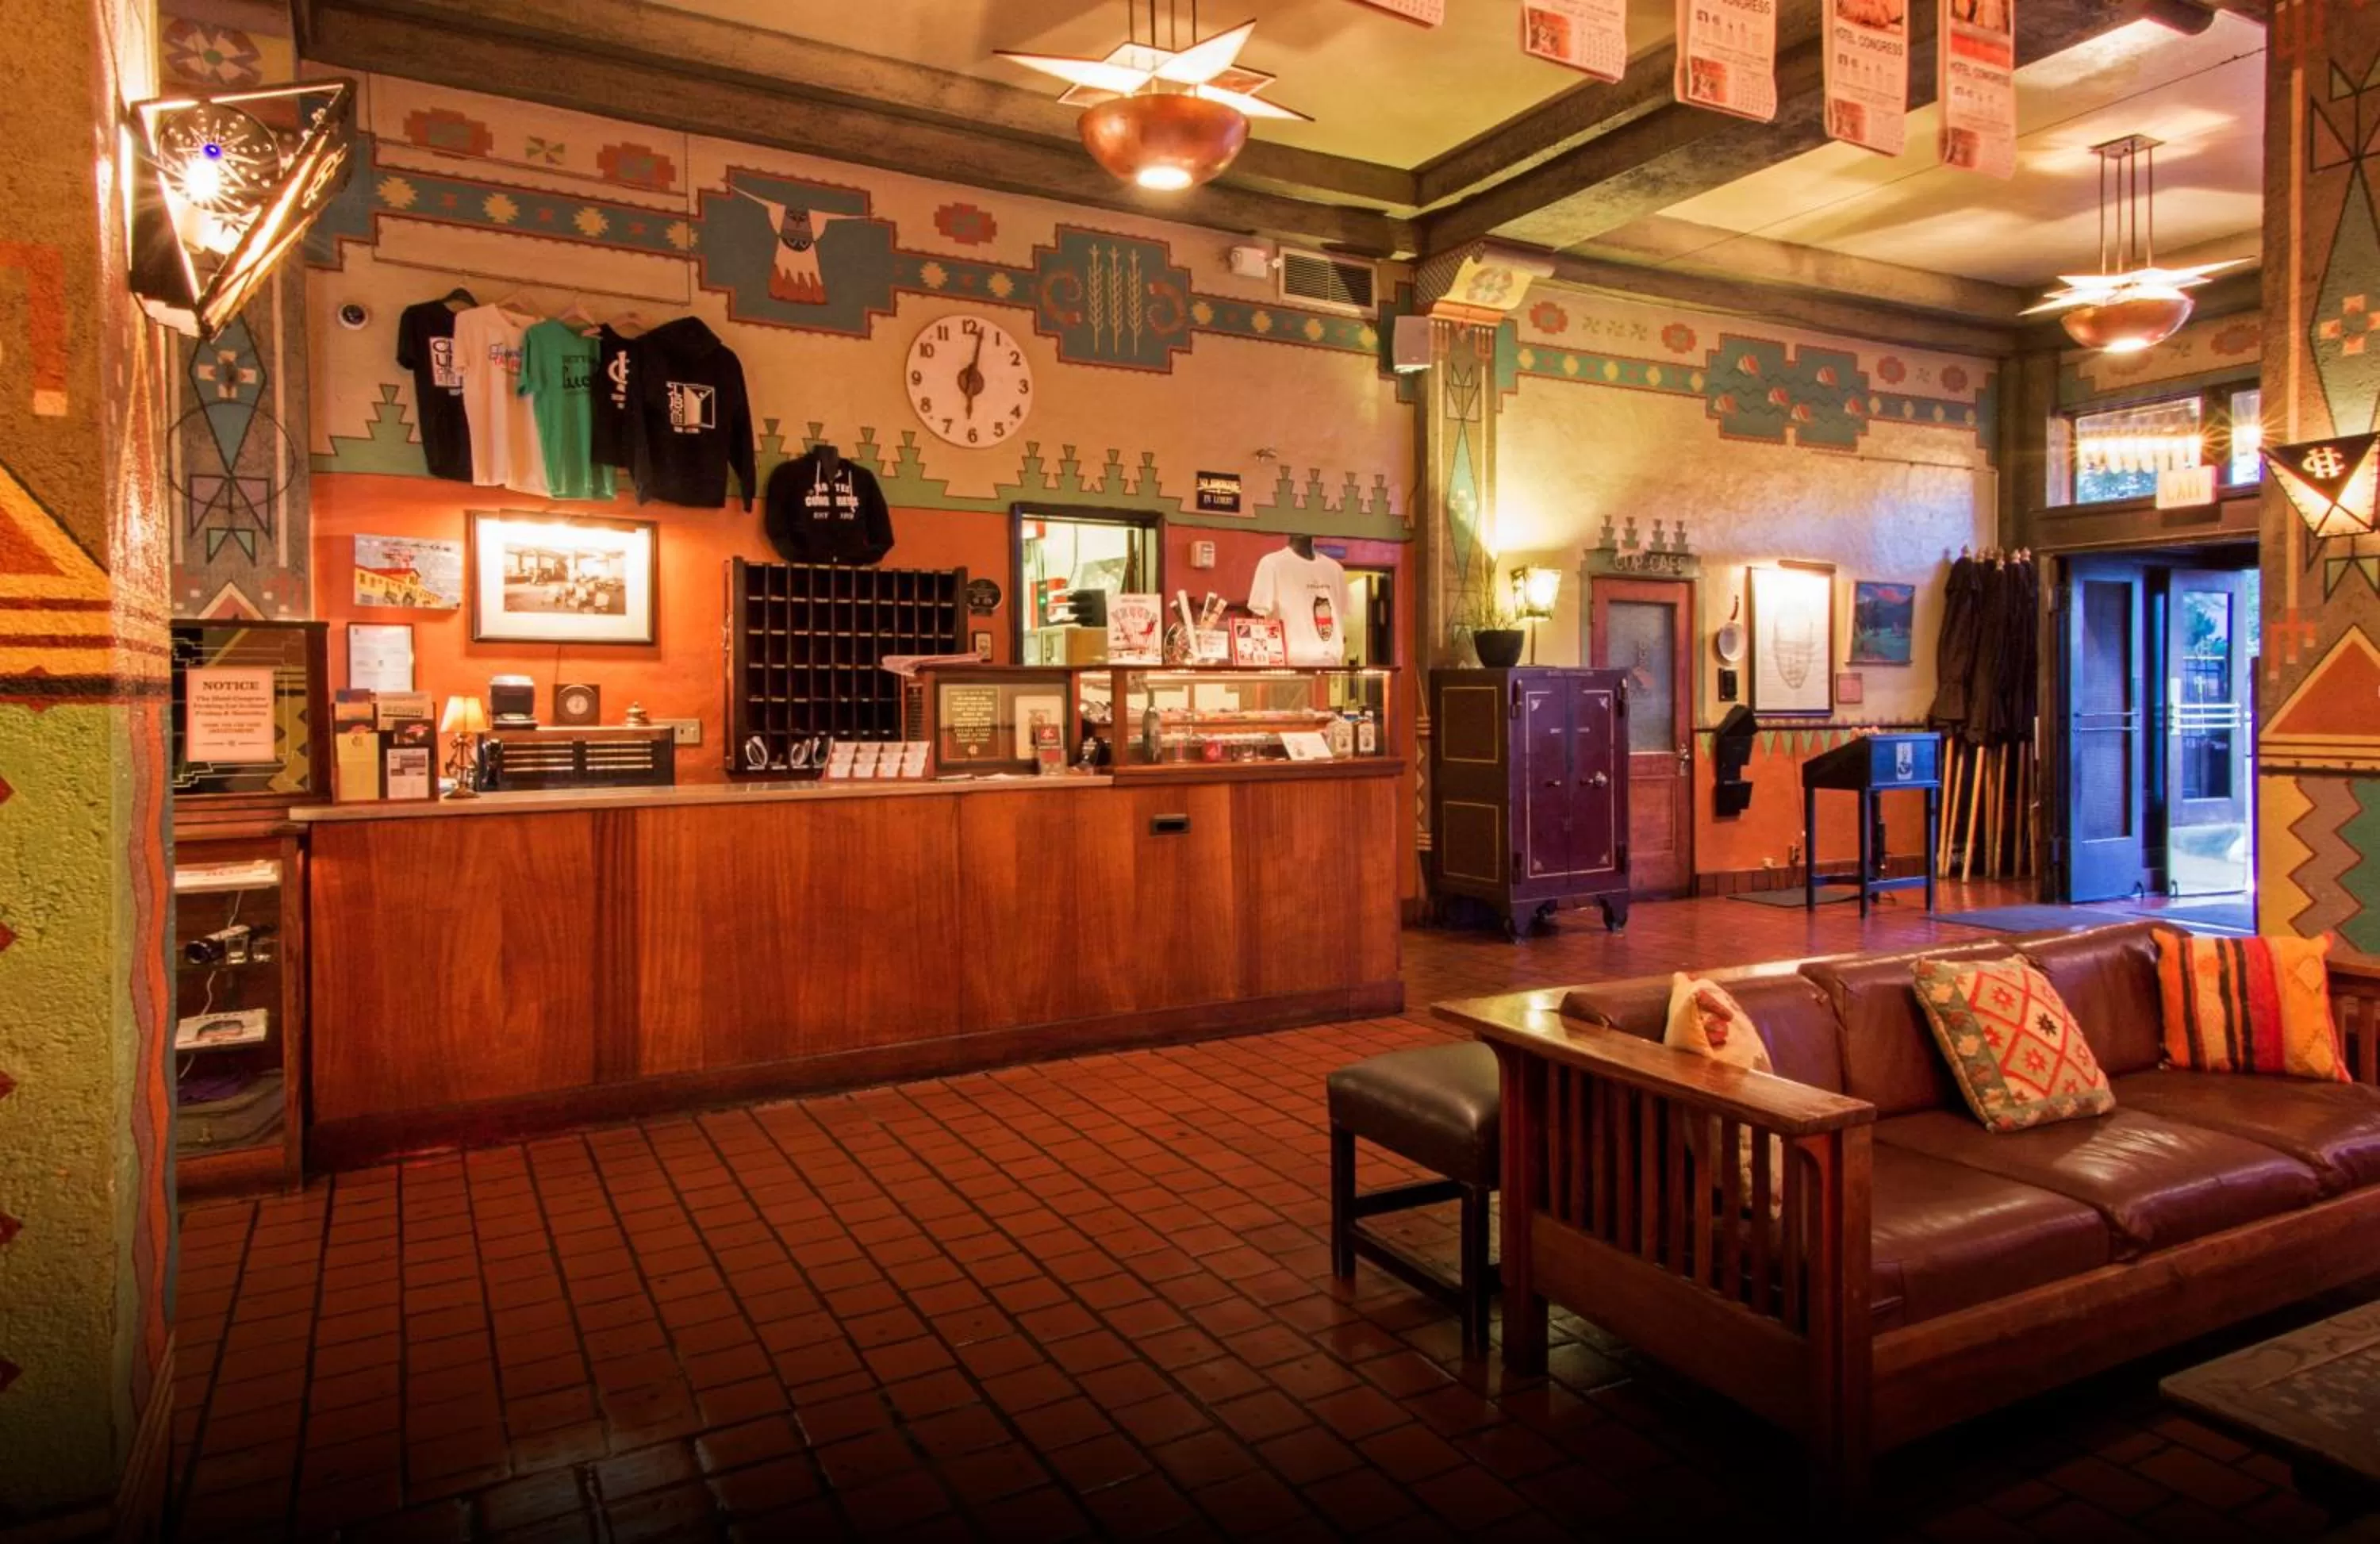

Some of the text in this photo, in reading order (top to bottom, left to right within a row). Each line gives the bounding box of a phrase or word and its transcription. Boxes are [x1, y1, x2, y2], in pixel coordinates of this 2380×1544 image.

[937, 325, 949, 341] 11
[962, 319, 978, 335] 12
[995, 332, 1000, 347] 1
[919, 342, 935, 358] 10
[1009, 350, 1021, 366] 2
[912, 370, 922, 386] 9
[1018, 378, 1029, 394] 3
[920, 397, 931, 413] 8
[1010, 404, 1021, 419] 4
[942, 418, 953, 434] 7
[993, 422, 1004, 437] 5
[967, 428, 978, 443] 6
[1614, 555, 1643, 571] CUP
[203, 681, 259, 690] NOTICE
